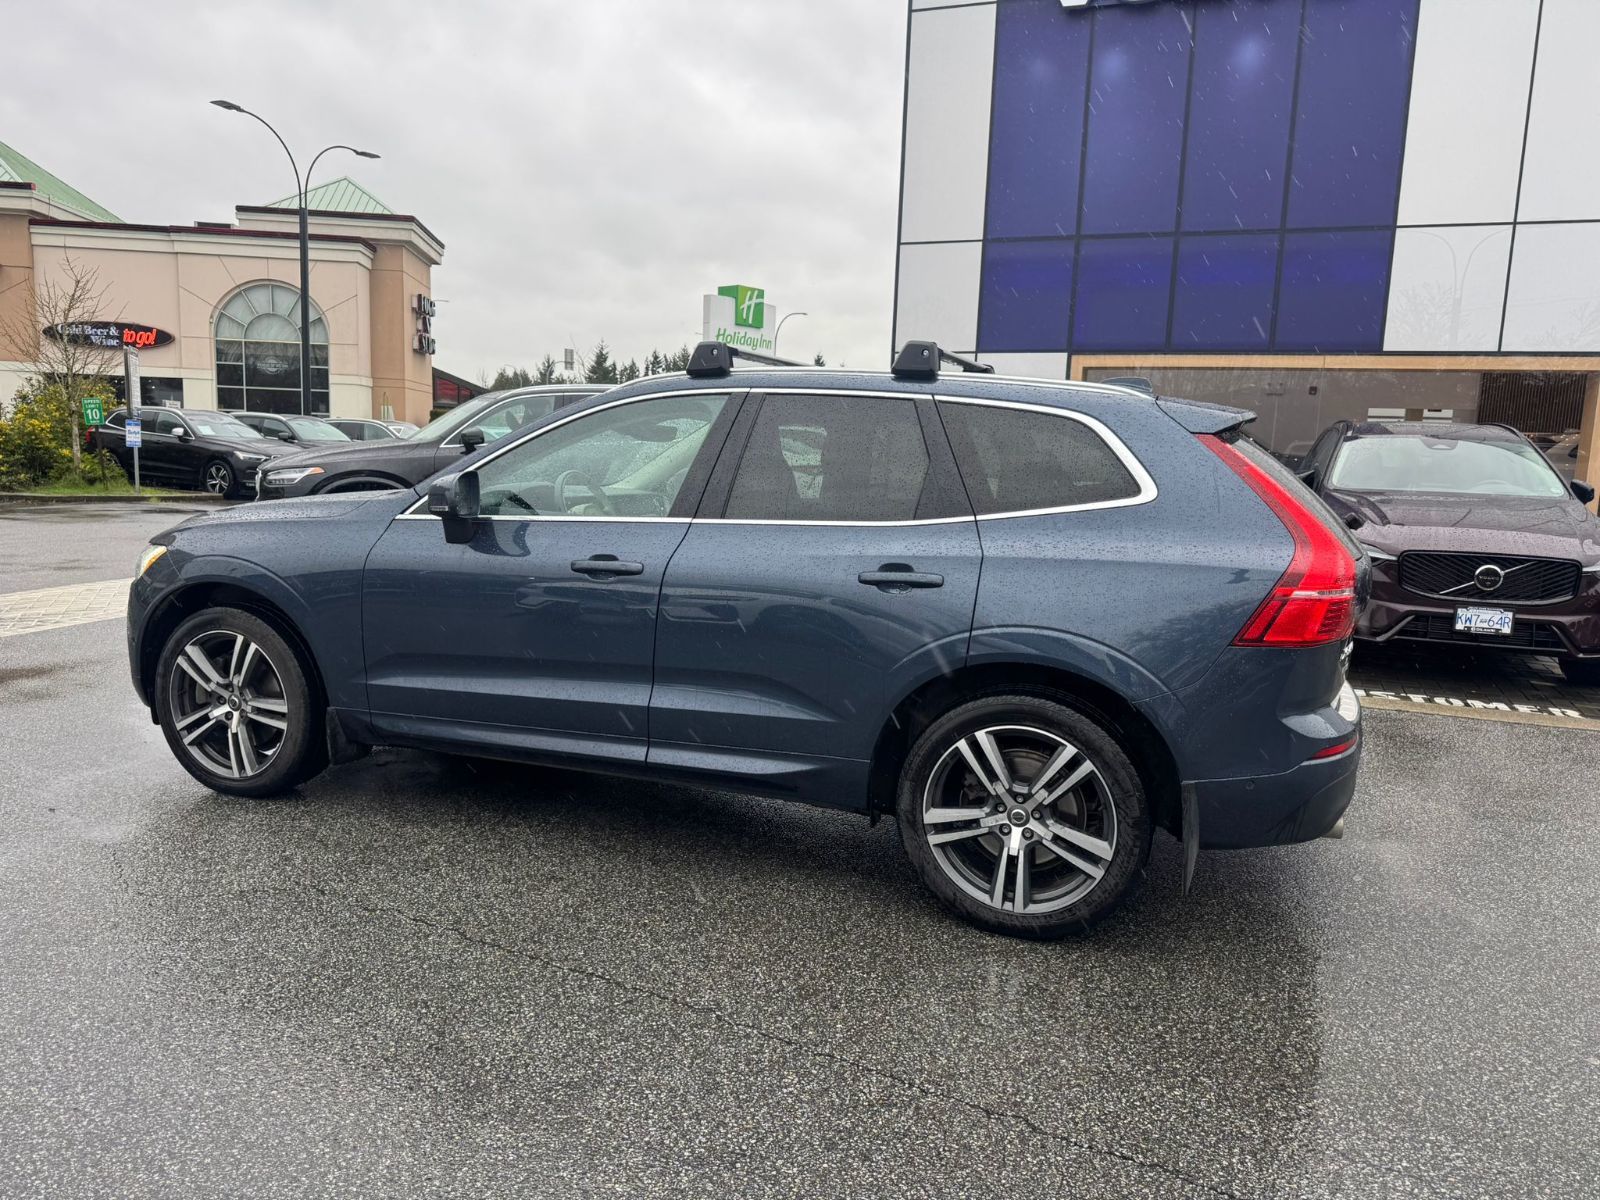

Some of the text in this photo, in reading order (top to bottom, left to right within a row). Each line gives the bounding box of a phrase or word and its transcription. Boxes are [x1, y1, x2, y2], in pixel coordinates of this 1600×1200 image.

[84, 325, 109, 336] Beer
[109, 326, 120, 336] &
[90, 335, 120, 346] Wine
[123, 328, 157, 347] to go!
[715, 327, 772, 351] Holiday Inn
[86, 408, 100, 420] 10
